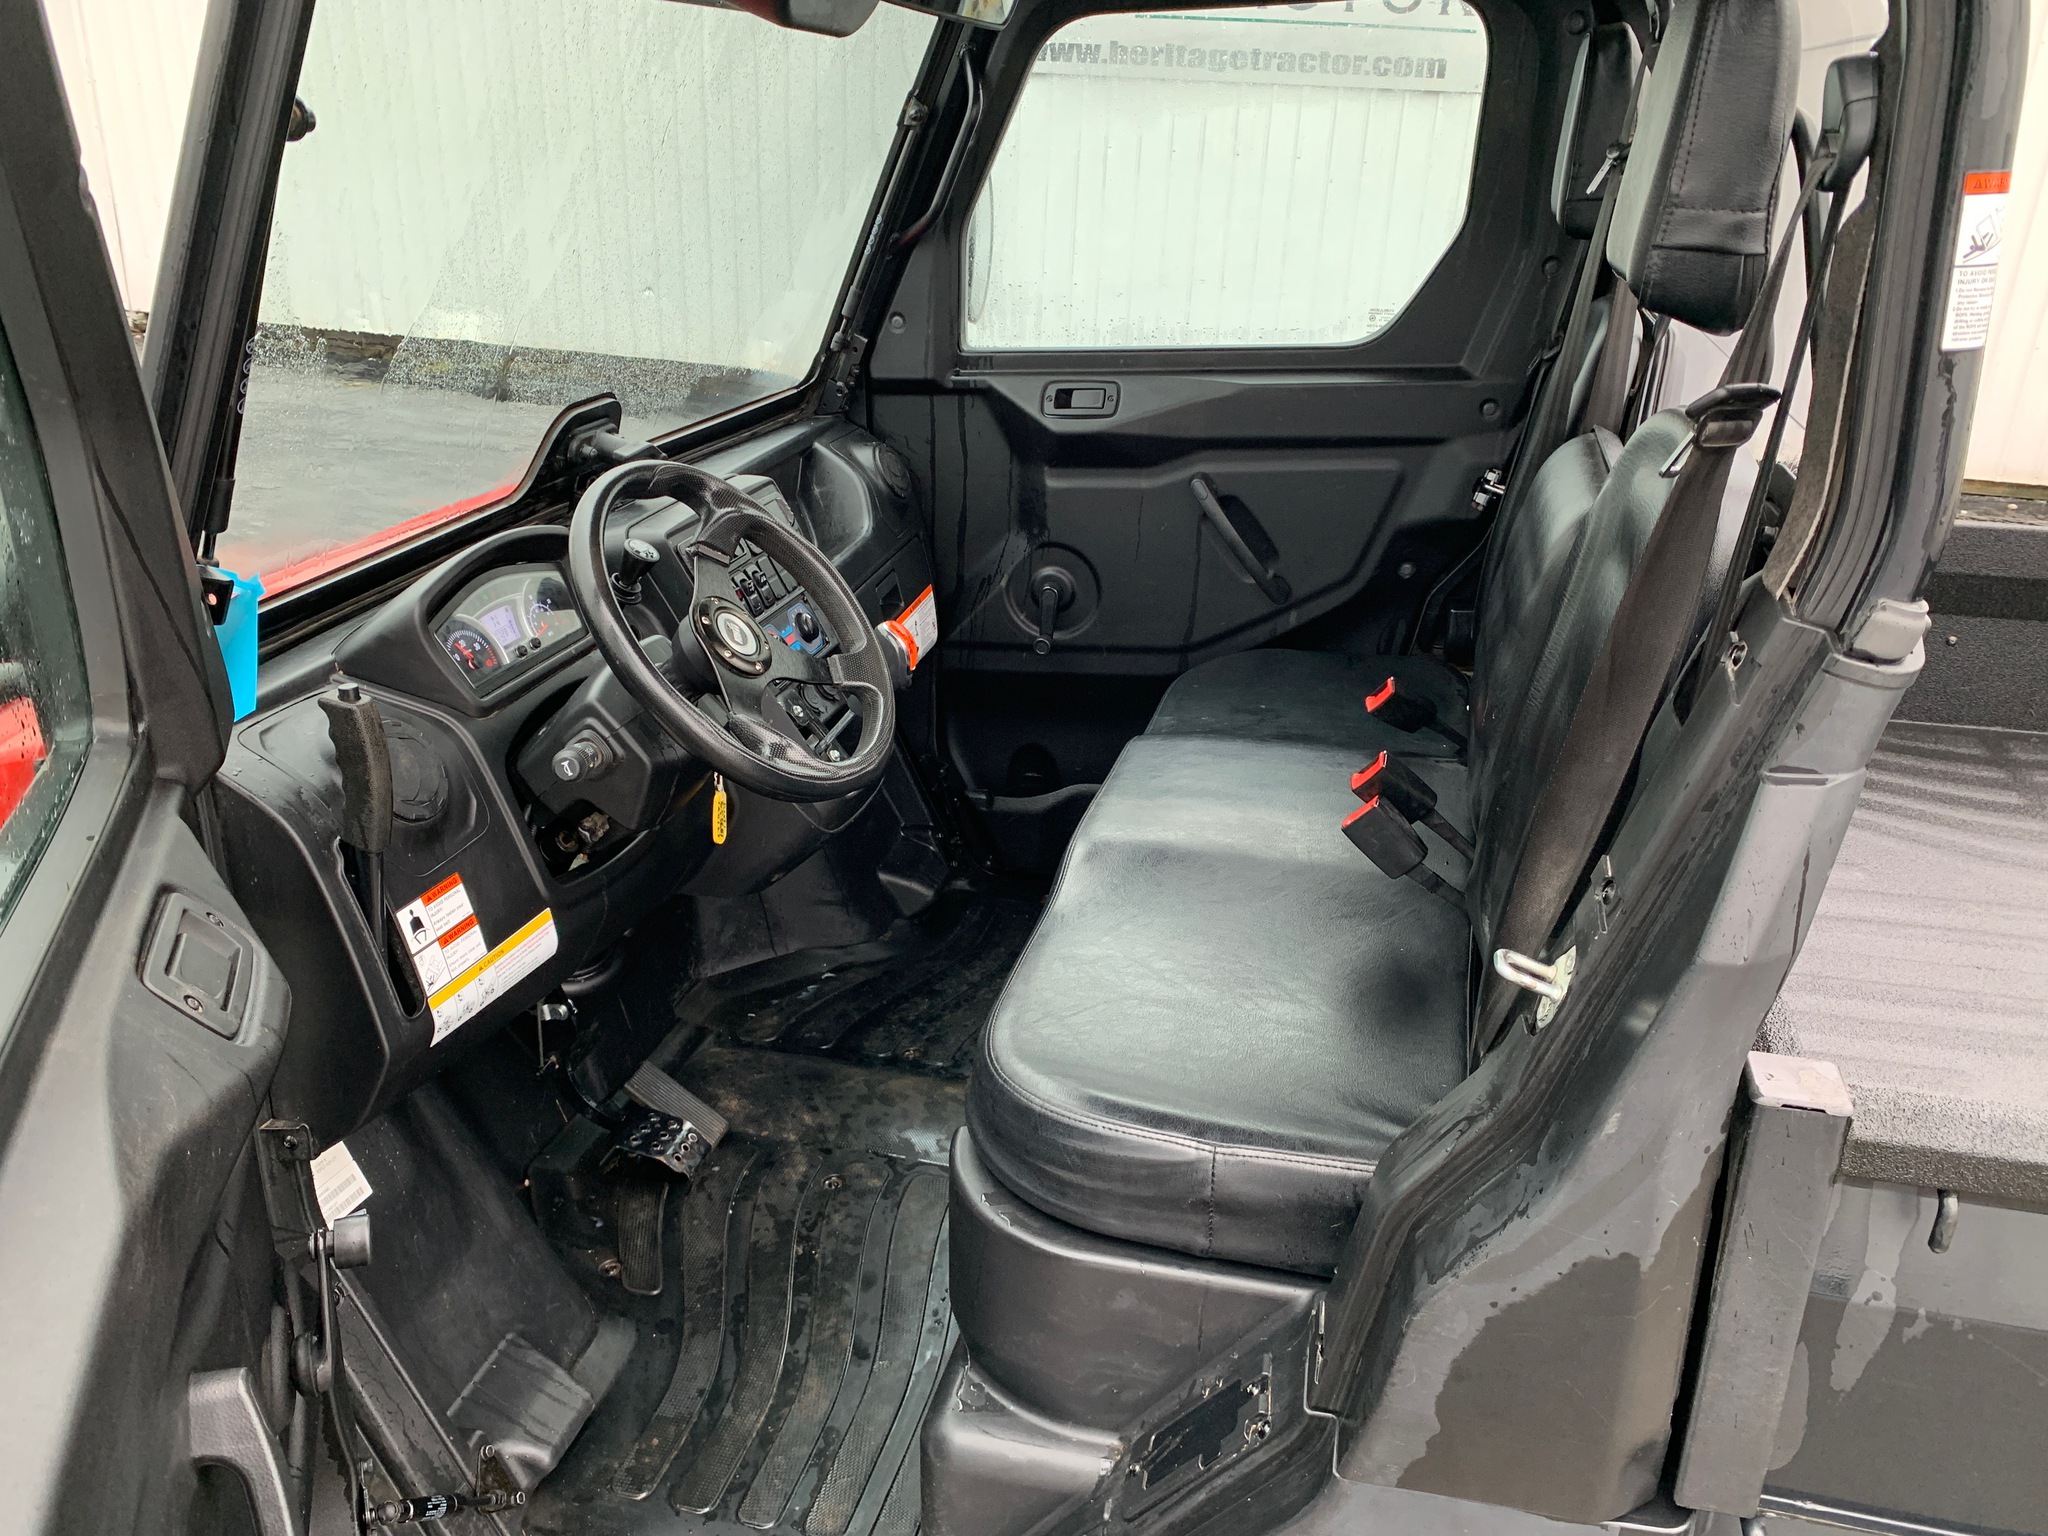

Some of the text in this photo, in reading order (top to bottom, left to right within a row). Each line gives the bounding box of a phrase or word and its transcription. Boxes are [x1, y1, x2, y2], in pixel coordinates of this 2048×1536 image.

[431, 877, 458, 898] WARNING
[448, 918, 474, 940] WARNING
[483, 948, 505, 968] CAUTION
